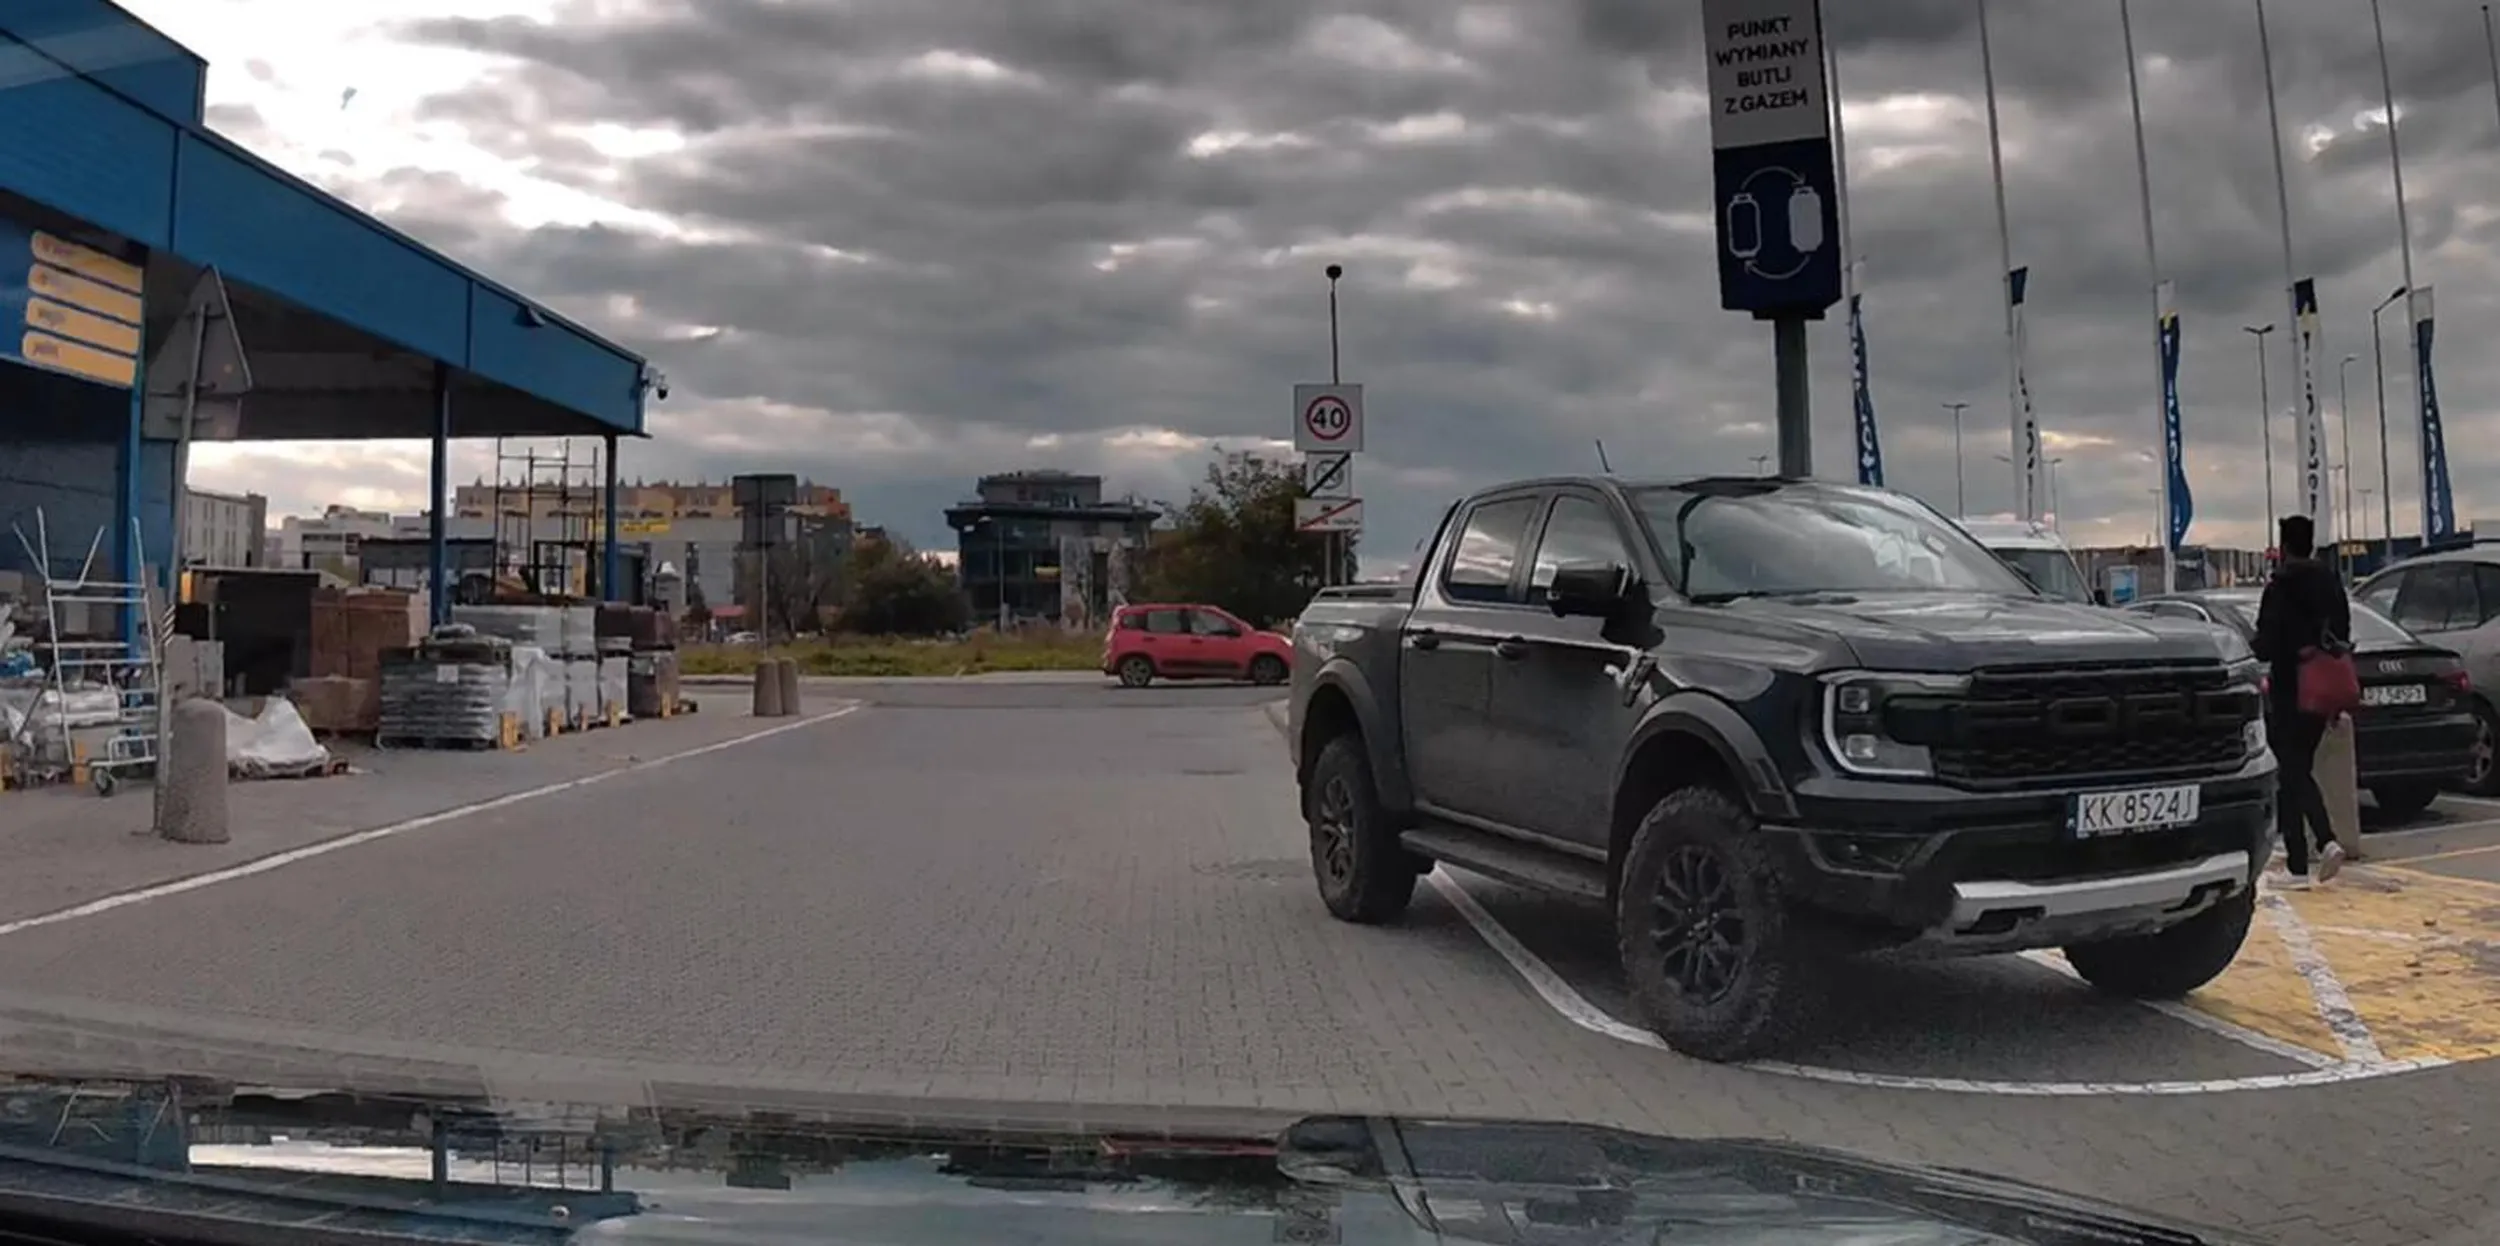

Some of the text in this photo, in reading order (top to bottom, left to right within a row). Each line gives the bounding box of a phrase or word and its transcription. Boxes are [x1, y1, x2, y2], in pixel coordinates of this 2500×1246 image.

[1727, 16, 1791, 39] PUNKT
[1716, 37, 1808, 66] WYMIANY
[1737, 65, 1791, 87] BUTLI
[1724, 88, 1807, 114] Z GAZEM
[1312, 407, 1344, 429] 40
[2084, 789, 2192, 828] KK 8524J
